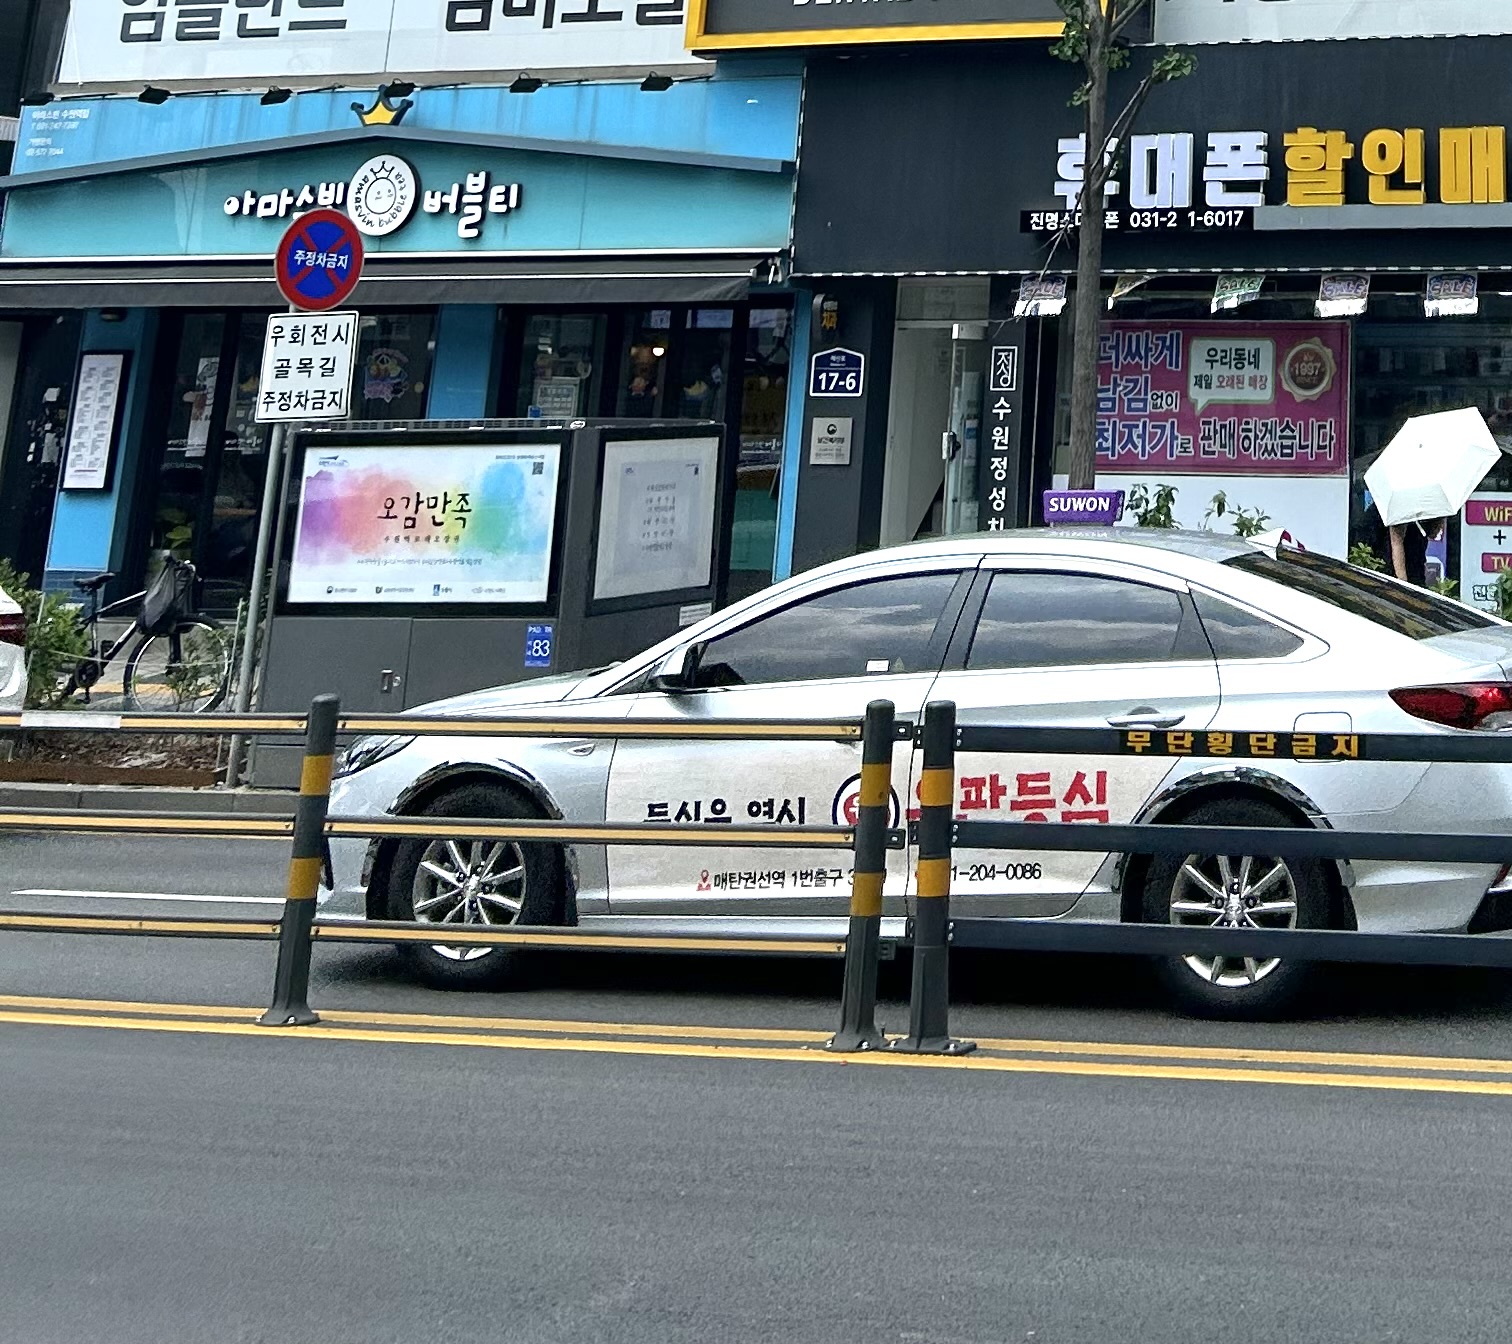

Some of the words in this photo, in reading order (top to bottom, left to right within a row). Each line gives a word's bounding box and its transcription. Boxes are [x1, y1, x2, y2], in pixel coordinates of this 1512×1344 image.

[422, 170, 519, 239] 버블티
[293, 248, 350, 270] 주정차금지
[270, 321, 351, 348] 우회전시
[273, 355, 337, 380] 골목길
[1204, 347, 1261, 371] 우리동네
[818, 372, 857, 391] 17-6
[261, 387, 344, 413] 주정차금지
[1199, 417, 1238, 460] 판매
[1239, 419, 1337, 461] 하겠습니다
[377, 491, 473, 530] 오감만족
[1049, 496, 1110, 513] SUWON
[532, 639, 551, 657] 83
[1126, 731, 1361, 759] 무단횡단금지
[713, 870, 787, 890] 매탄권선역
[950, 862, 1042, 882] 1-204-0086
